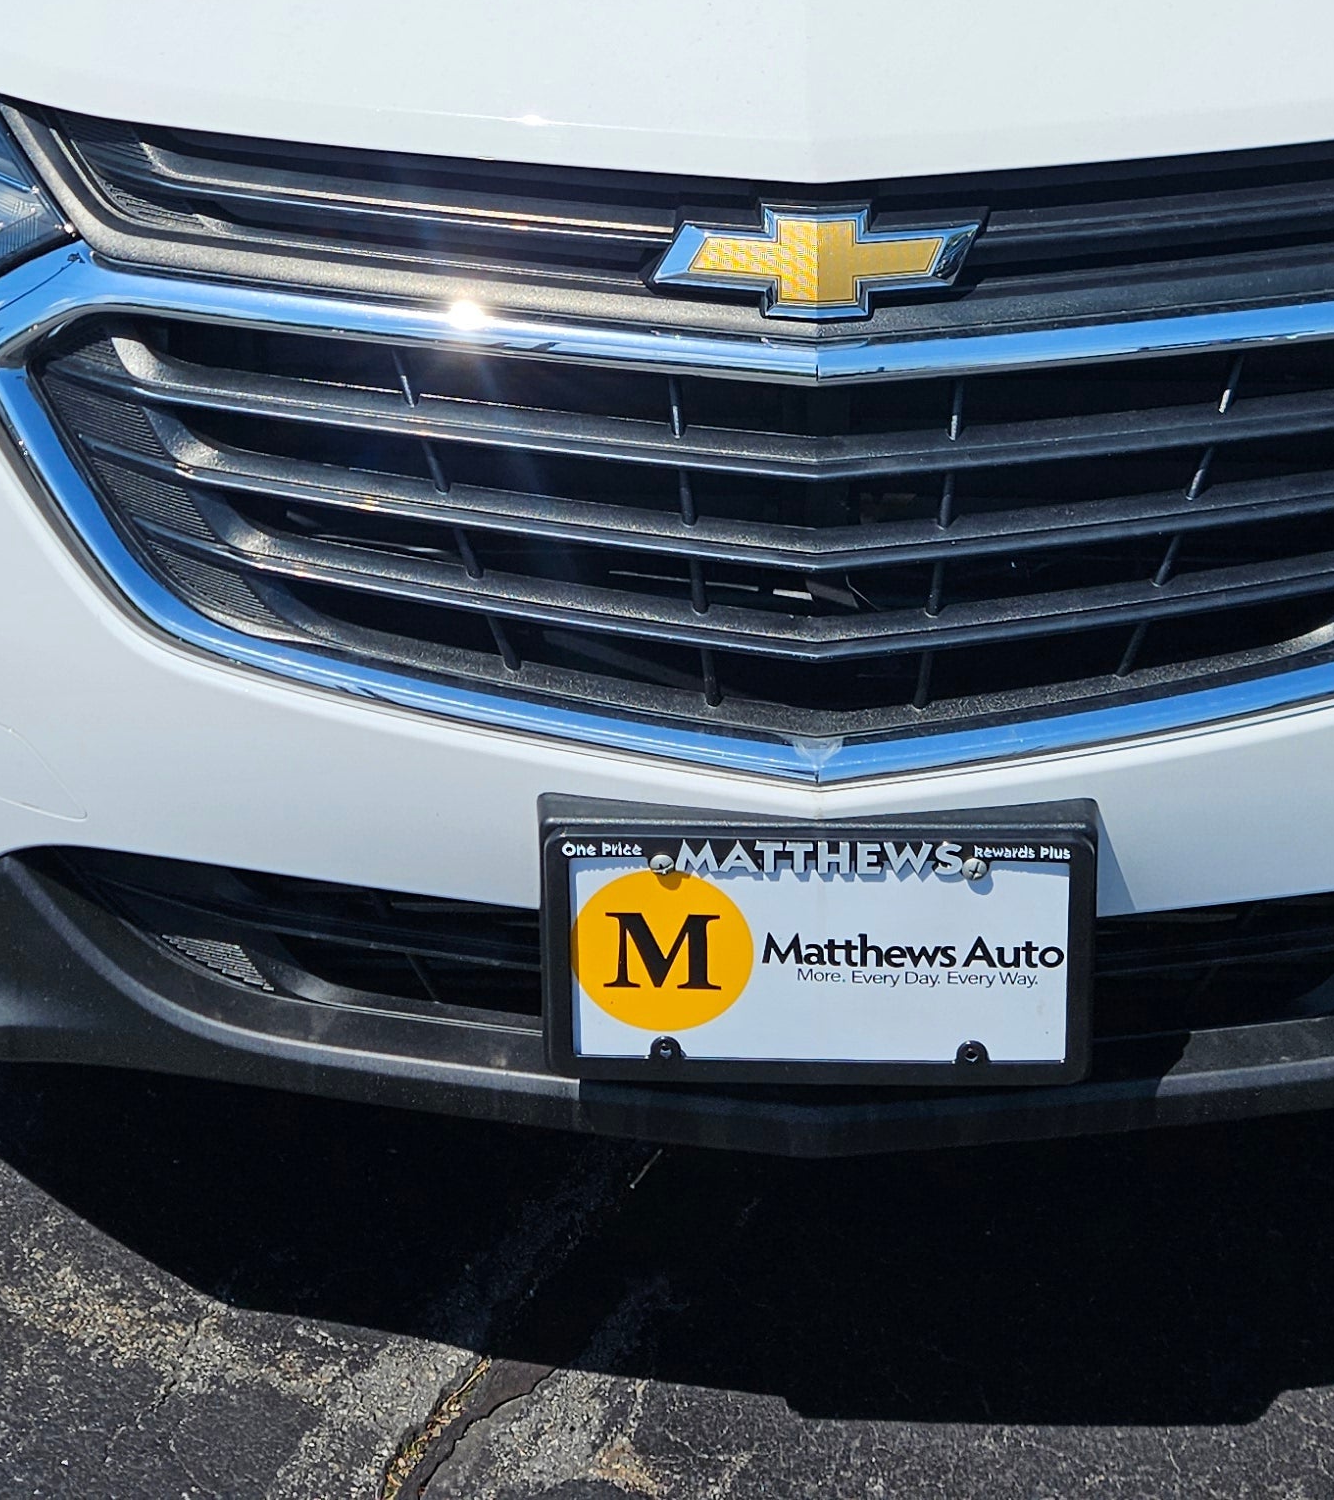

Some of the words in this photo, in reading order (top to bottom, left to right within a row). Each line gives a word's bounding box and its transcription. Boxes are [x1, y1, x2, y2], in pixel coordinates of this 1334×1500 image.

[561, 841, 597, 857] One
[601, 841, 643, 857] Price
[675, 838, 964, 876] MATTHEWS
[974, 845, 1036, 859] Rewards
[1040, 845, 1072, 860] Plus
[603, 911, 722, 991] M
[761, 931, 957, 968] Matthews
[961, 935, 1065, 969] Auto
[797, 968, 846, 983] More.
[851, 970, 900, 988] Every
[904, 970, 941, 987] Day.
[947, 971, 995, 989] Every
[999, 971, 1039, 987] Way.
